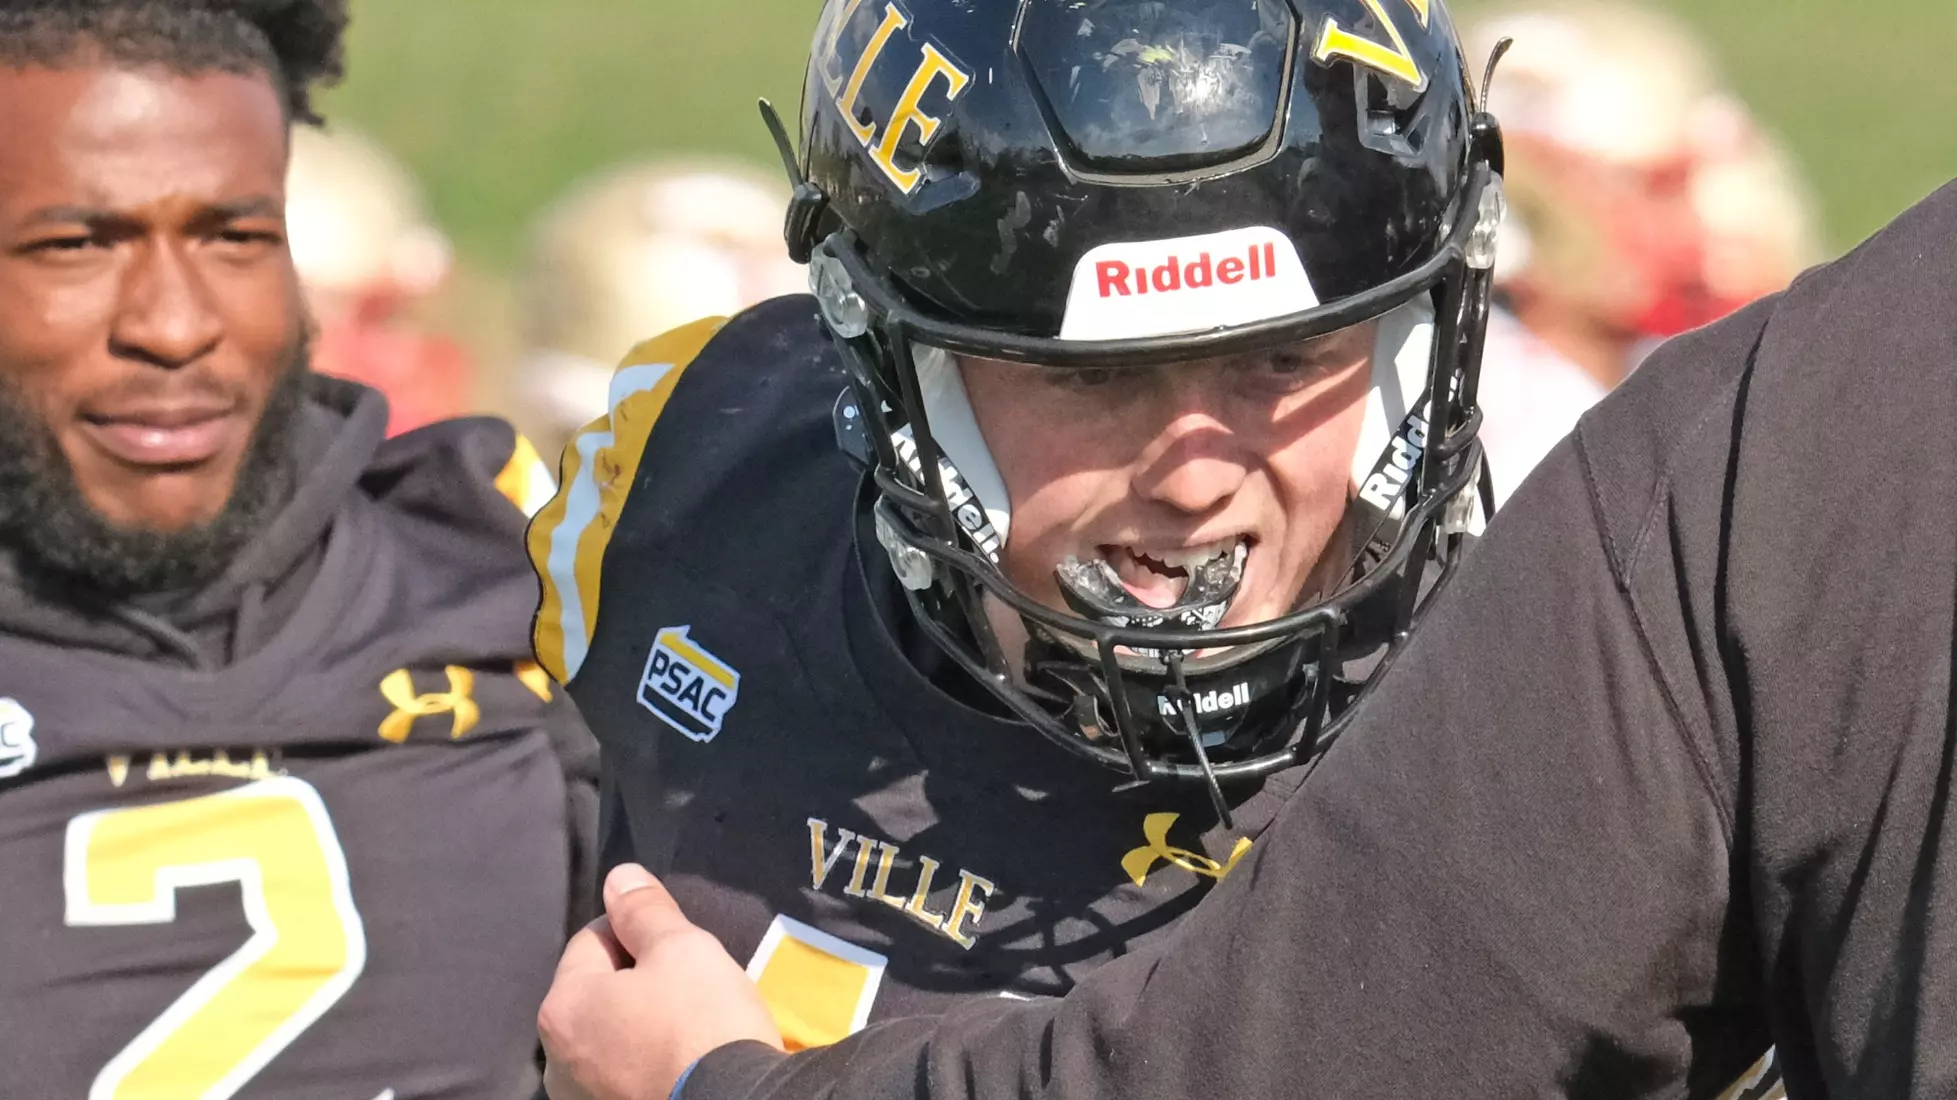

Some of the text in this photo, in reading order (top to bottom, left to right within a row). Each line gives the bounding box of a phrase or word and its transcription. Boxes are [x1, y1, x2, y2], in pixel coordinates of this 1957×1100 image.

[1096, 242, 1276, 298] Riddell
[1359, 376, 1458, 511] Ridd
[647, 648, 727, 723] PSAC
[64, 776, 394, 1100] 2
[807, 817, 995, 951] VILLE
